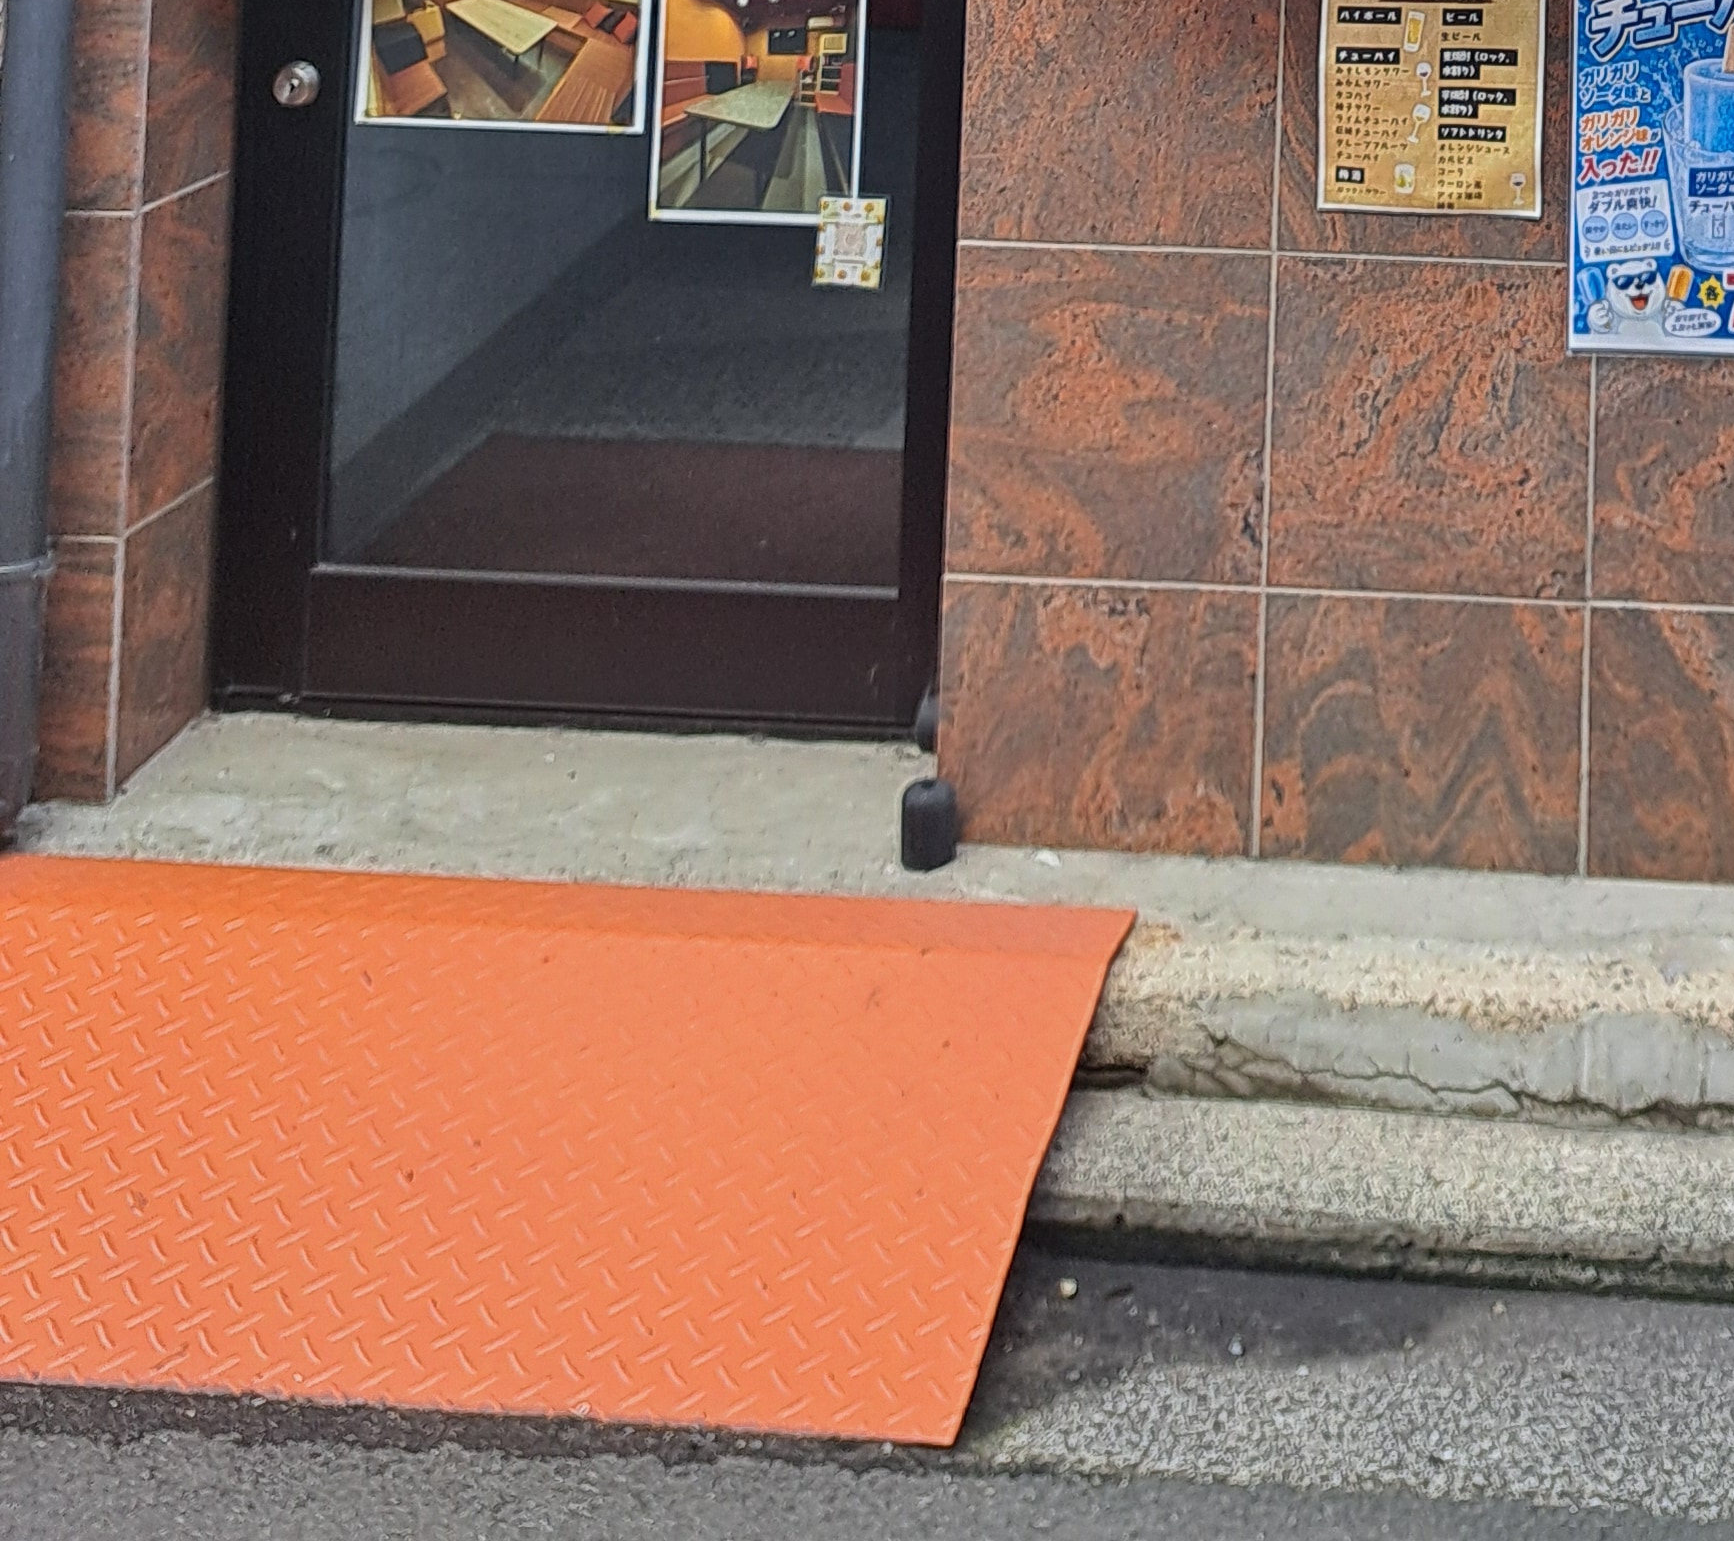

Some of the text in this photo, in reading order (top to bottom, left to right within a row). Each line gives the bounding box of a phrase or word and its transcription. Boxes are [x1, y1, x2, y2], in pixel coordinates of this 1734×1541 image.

[1339, 10, 1397, 22] ハイボール
[1445, 12, 1480, 23] ビール
[1338, 50, 1396, 62] チューハイ
[1580, 61, 1639, 89] ガリガリ
[1580, 108, 1639, 132] ガリガリ
